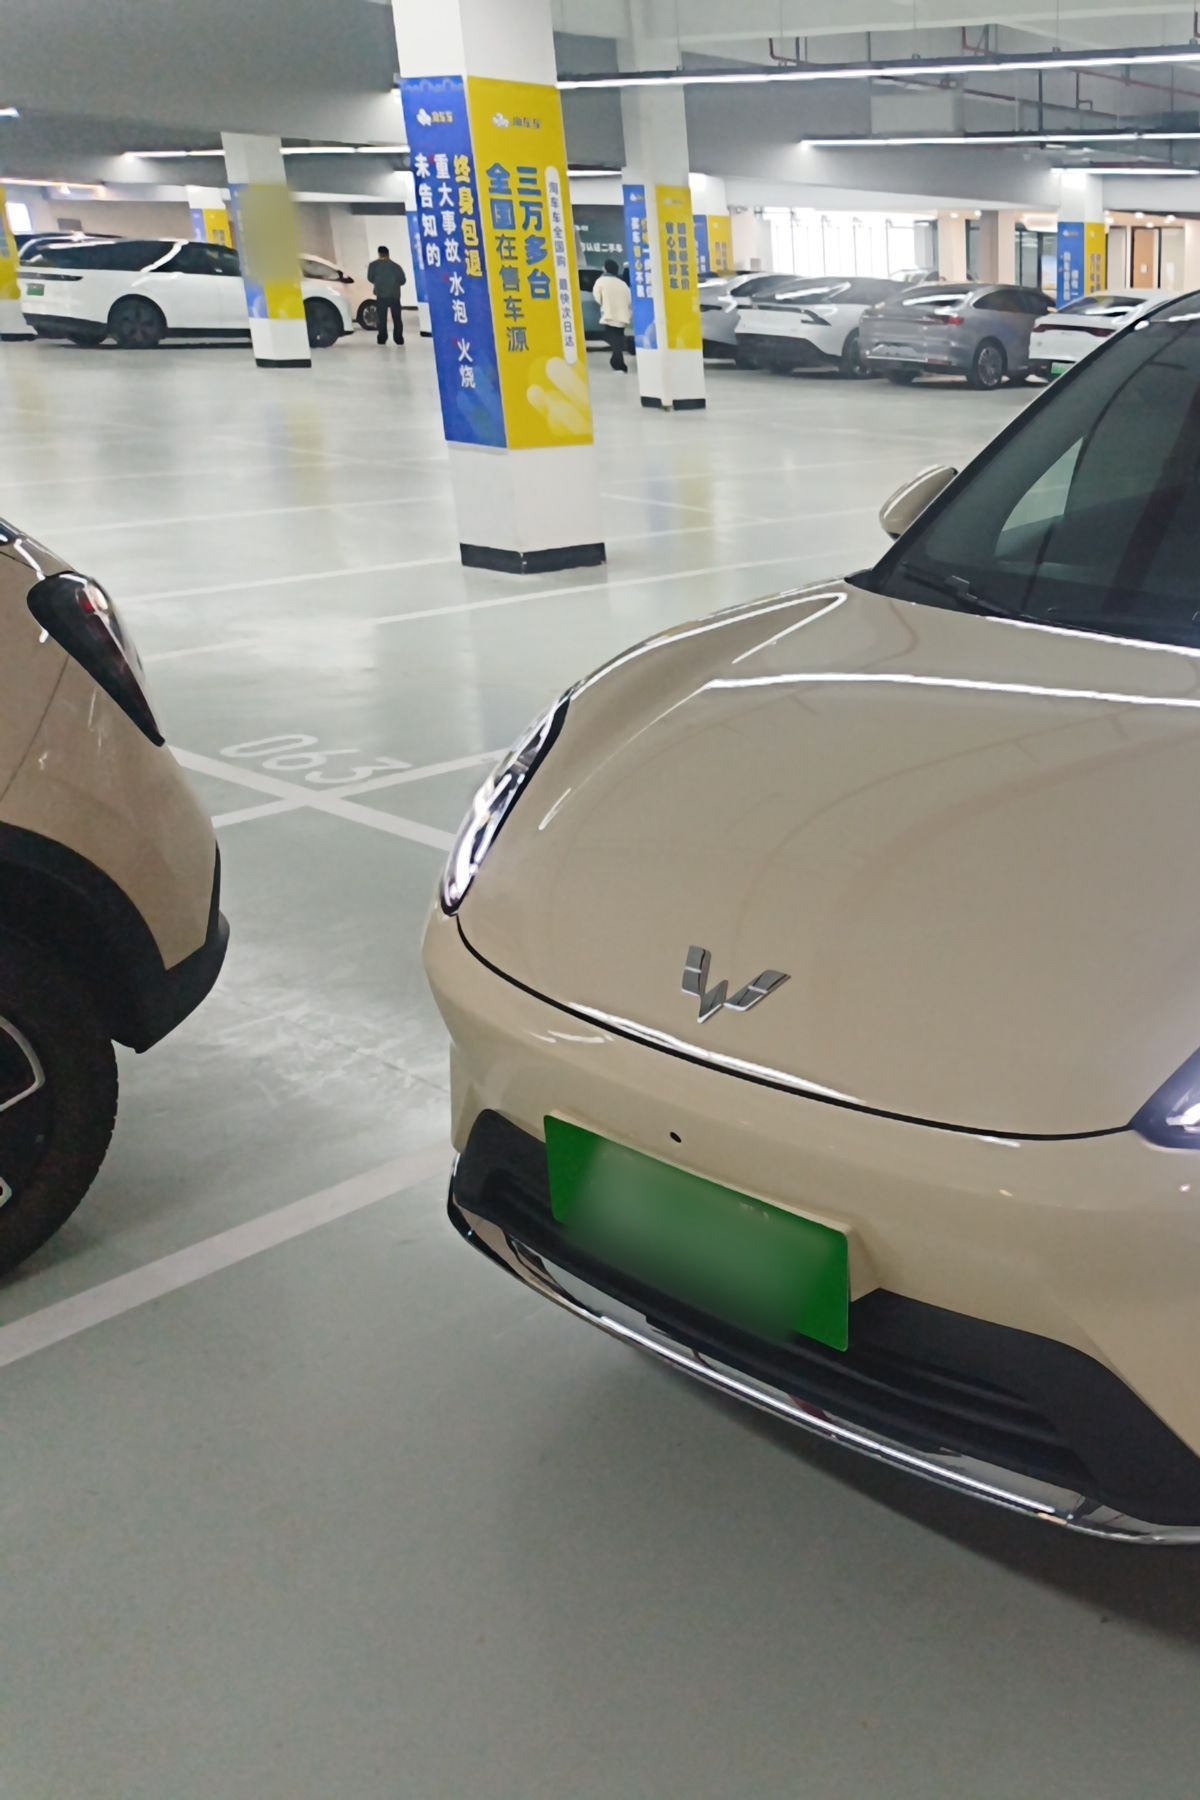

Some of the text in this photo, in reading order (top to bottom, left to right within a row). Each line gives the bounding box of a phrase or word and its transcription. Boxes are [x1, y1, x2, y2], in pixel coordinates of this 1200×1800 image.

[415, 153, 441, 267] 未告知的
[434, 153, 476, 389] 重大事故 水泡 火烧
[454, 154, 482, 277] 终身包退
[486, 162, 529, 352] 全国在售车源
[516, 166, 551, 299] 三万多台
[220, 734, 413, 783] 063
